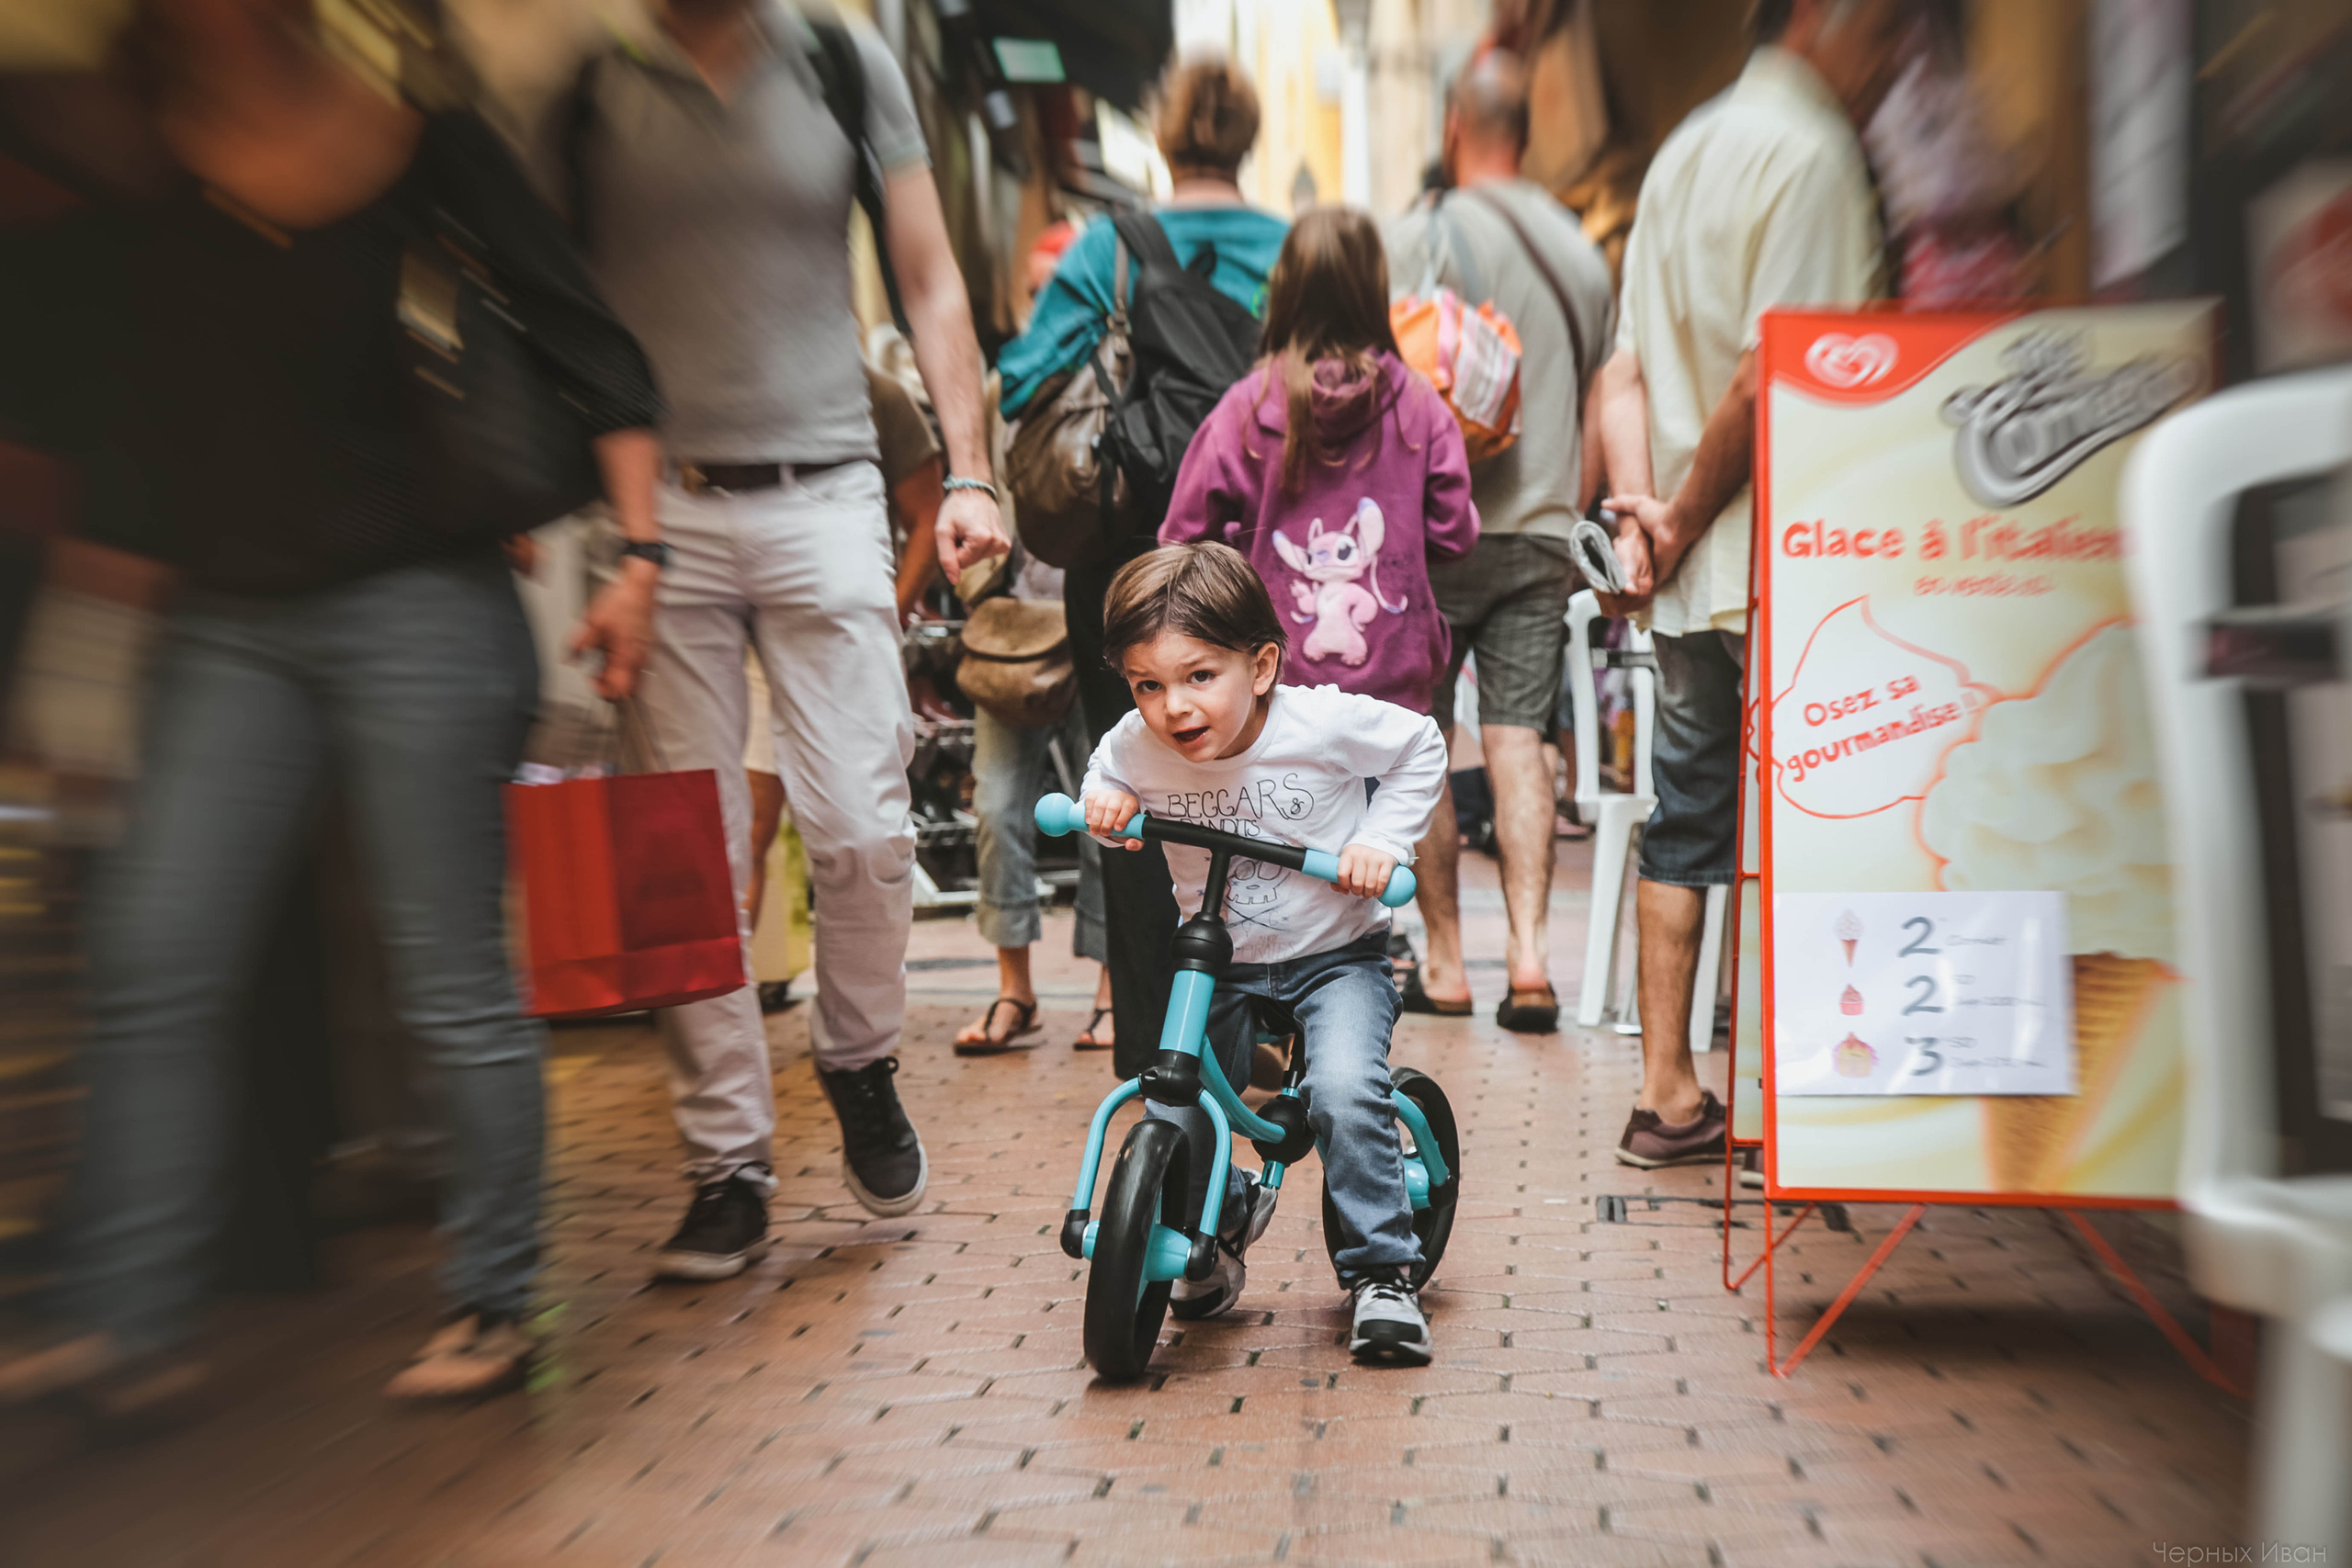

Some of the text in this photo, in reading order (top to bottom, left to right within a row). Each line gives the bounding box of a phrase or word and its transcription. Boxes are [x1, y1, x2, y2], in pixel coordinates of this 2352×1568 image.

[1781, 517, 1905, 559] Glace
[1803, 673, 1922, 728] Osez sa
[1786, 701, 1962, 784] gourmandise
[1897, 916, 1942, 958] 2
[1900, 975, 1946, 1016] 2
[1903, 1036, 1945, 1076] 3
